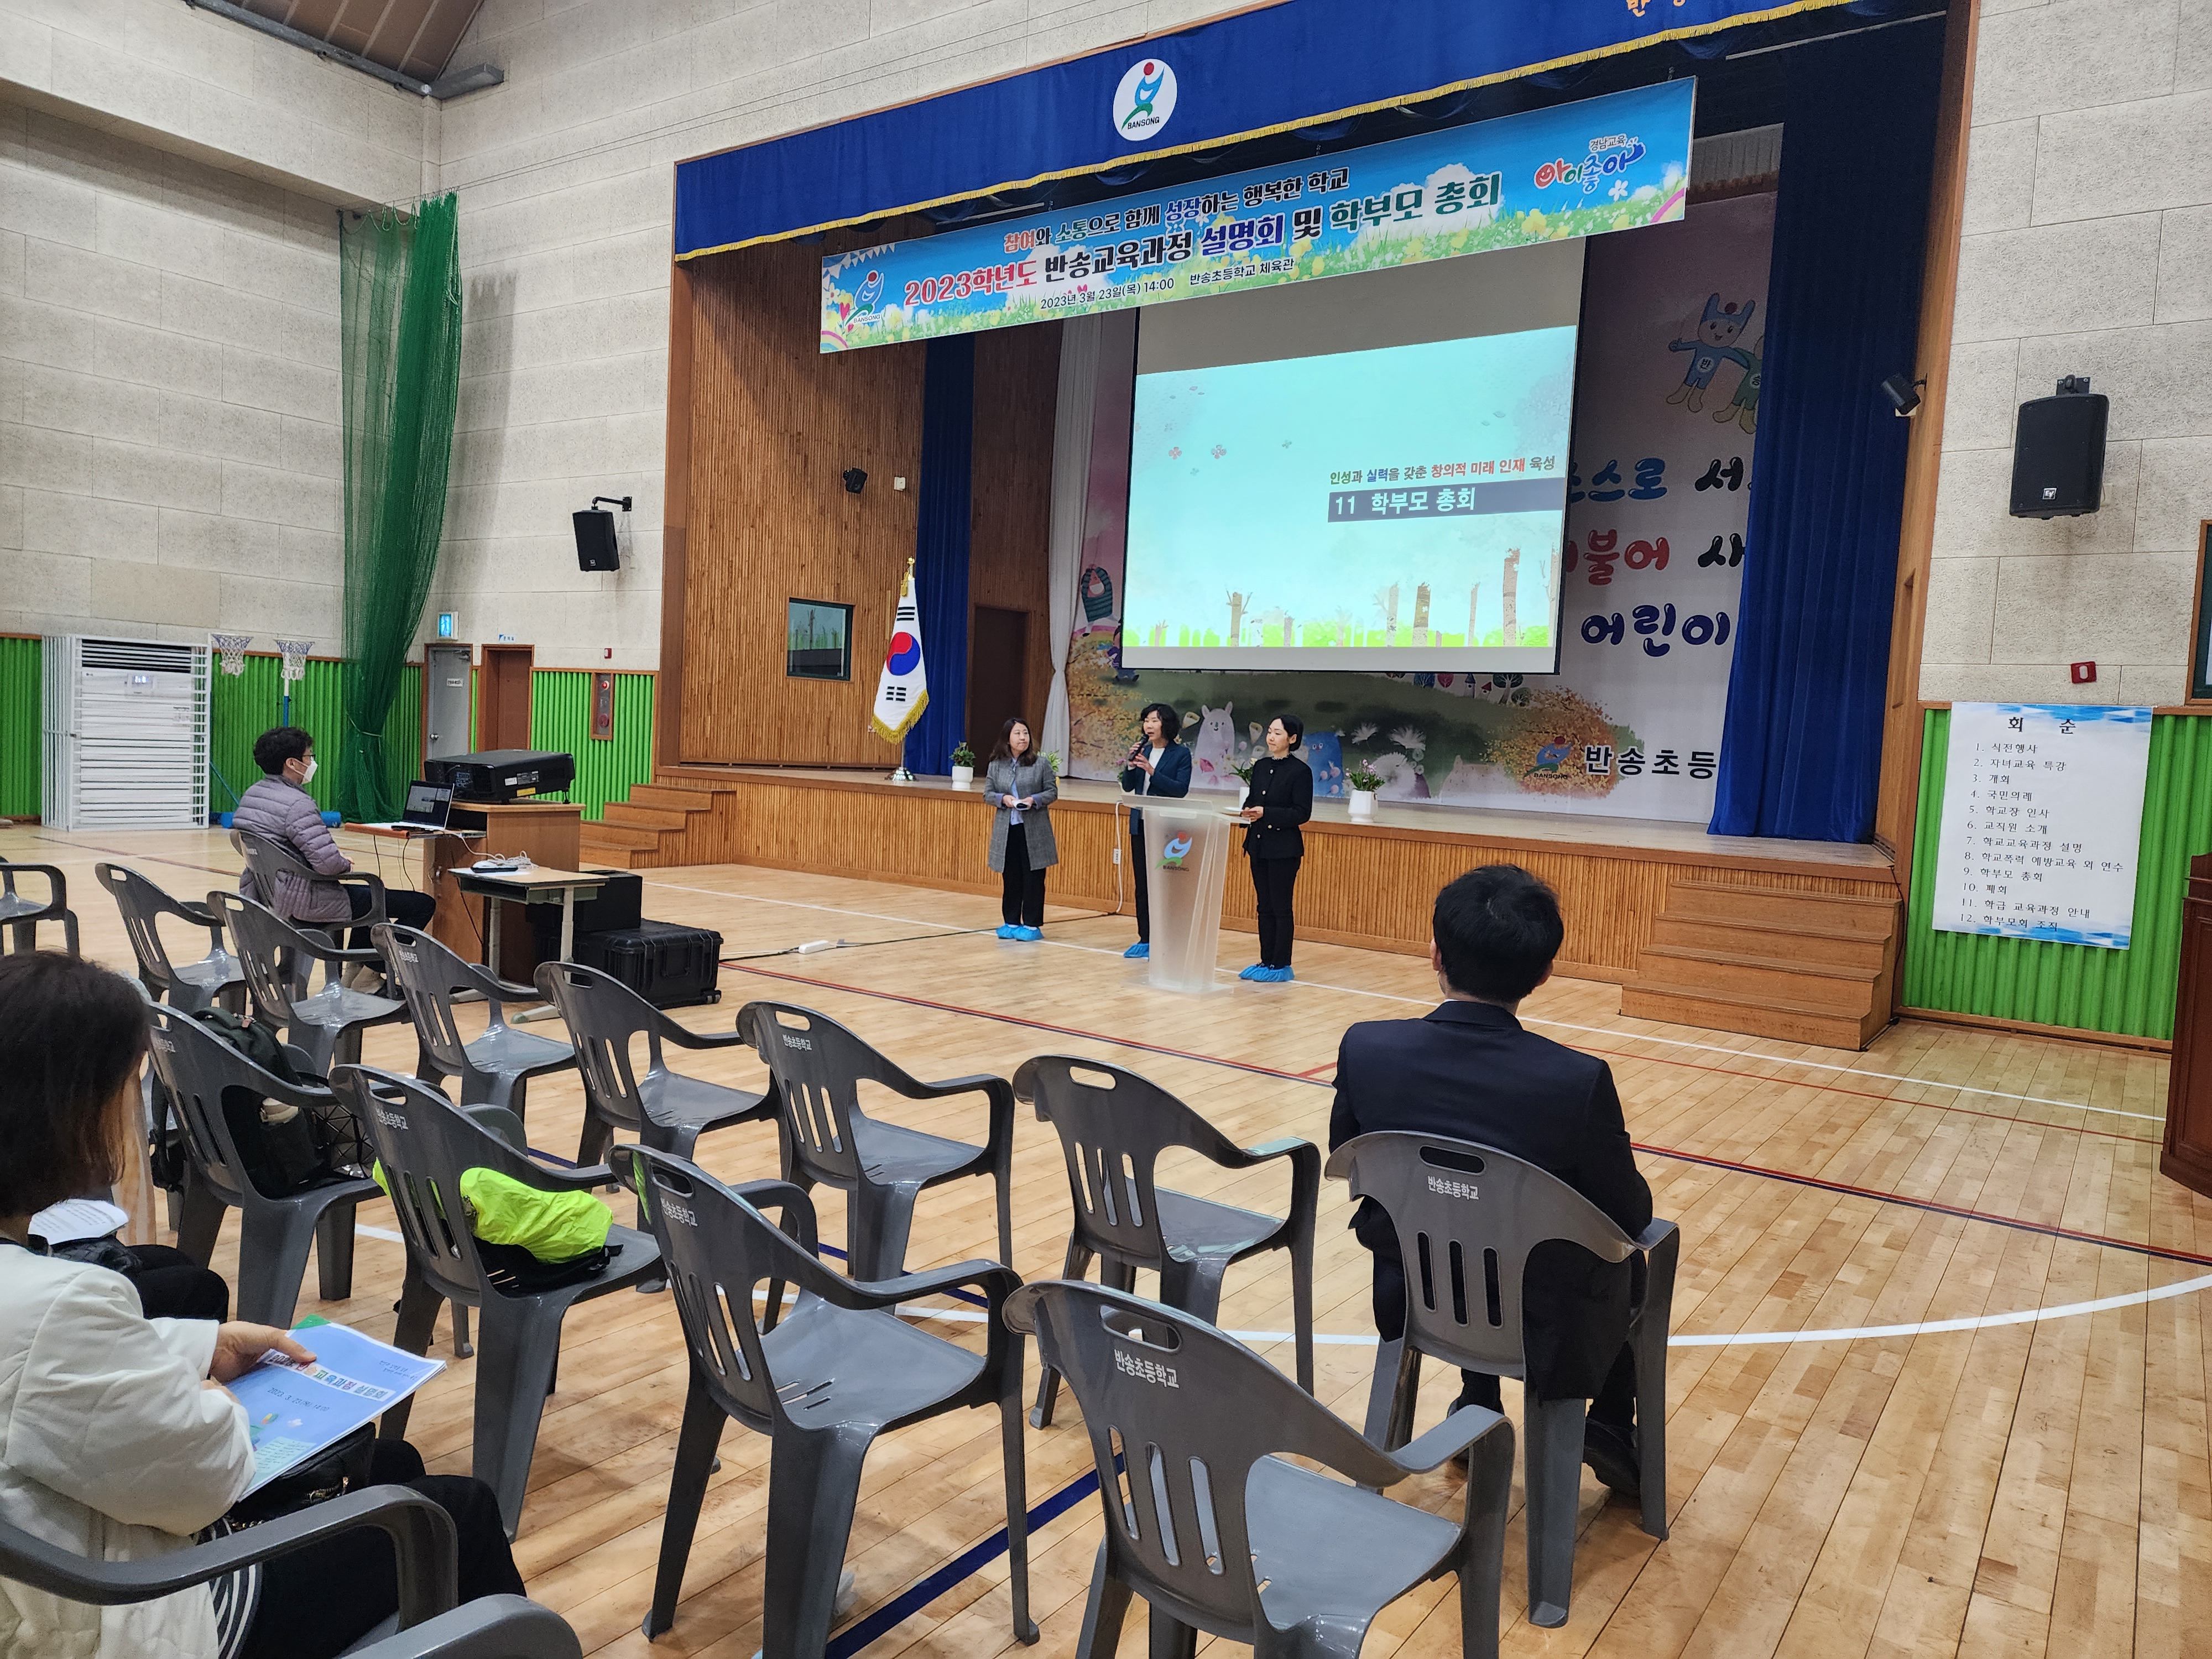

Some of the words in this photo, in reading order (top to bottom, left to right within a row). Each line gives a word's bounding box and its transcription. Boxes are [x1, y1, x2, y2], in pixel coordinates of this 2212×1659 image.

[1127, 116, 1160, 130] BANSONG
[1590, 134, 1627, 151] 경남교육
[1535, 144, 1645, 194] 아이좋아
[1004, 227, 1051, 253] 참여와
[1055, 213, 1120, 243] 소통으로
[1125, 205, 1161, 229] 함께
[1166, 192, 1238, 221] 성장하는
[1244, 178, 1303, 207] 행복한
[1308, 168, 1348, 192] 학교
[905, 260, 1037, 305] 2023학년도
[1045, 232, 1191, 283] 반송교육과정
[1202, 215, 1284, 256] 설명회
[1294, 208, 1321, 241] 및
[1331, 190, 1423, 231] 학부모
[1435, 174, 1500, 215] 총회
[1190, 265, 1255, 285] 반송초등학교
[1259, 258, 1295, 274] 체육관
[1041, 295, 1076, 309] 2023년
[1079, 291, 1095, 303] 3월
[1098, 282, 1140, 300] 23일(목)
[1144, 278, 1174, 293] 14:00
[853, 314, 880, 323] BANSONG
[1330, 469, 1363, 485] 인성과
[1366, 467, 1400, 482] 실력을
[1404, 465, 1427, 481] 갖춘
[1431, 462, 1467, 478] 창의적
[1470, 460, 1495, 475] 미래
[1499, 458, 1526, 473] 인재
[1529, 455, 1556, 471] 육성
[1694, 457, 1752, 492] 서
[1335, 496, 1355, 515] 11
[1371, 491, 1428, 515] 학부모
[1436, 487, 1475, 512] 총회
[1566, 529, 1670, 586] 불어
[1581, 603, 1730, 658] 어린이
[2007, 716, 2024, 733] 회
[2058, 718, 2077, 735] 순
[1976, 743, 1985, 752] 1.
[1991, 743, 2038, 754] 식전행사
[1974, 758, 1983, 768] 2.
[1990, 758, 2036, 770] 자녀교육
[2043, 760, 2067, 772] 특강
[1972, 774, 1981, 783] 3.
[1989, 774, 2010, 785] 개회
[1970, 790, 1980, 799] 4.
[1987, 790, 2033, 802] 국민의례
[1969, 805, 1978, 815] 5.
[1986, 805, 2020, 817] 학교장
[2027, 807, 2050, 819] 인사
[1967, 821, 1977, 830] 6.
[1984, 821, 2017, 833] 교직원
[2025, 823, 2048, 835] 소개
[1966, 836, 1976, 845] 7.
[1983, 836, 2052, 851] 학교교육과정
[2059, 842, 2083, 854] 설명
[1964, 852, 1974, 860] 8.
[1981, 852, 2025, 865] 학교폭력
[2031, 856, 2077, 869] 예방교육
[2101, 860, 2124, 873] 연수
[1963, 867, 1973, 876] 9.
[1980, 867, 2013, 879] 학부모
[2021, 871, 2043, 883] 총회
[1963, 882, 1978, 892] 10.
[1961, 898, 1977, 907] 11.
[1984, 899, 2006, 911] 학급
[2013, 902, 2059, 916] 교육과정
[2067, 907, 2090, 919] 안내
[1960, 914, 1976, 923] 12.
[1983, 914, 2028, 928] 학부모회
[2035, 920, 2058, 932] 조직
[782, 1034, 812, 1051] 반송초등학교
[1427, 1175, 1479, 1200] 반송초등학교
[1114, 1348, 1180, 1389] 반송초등학교
